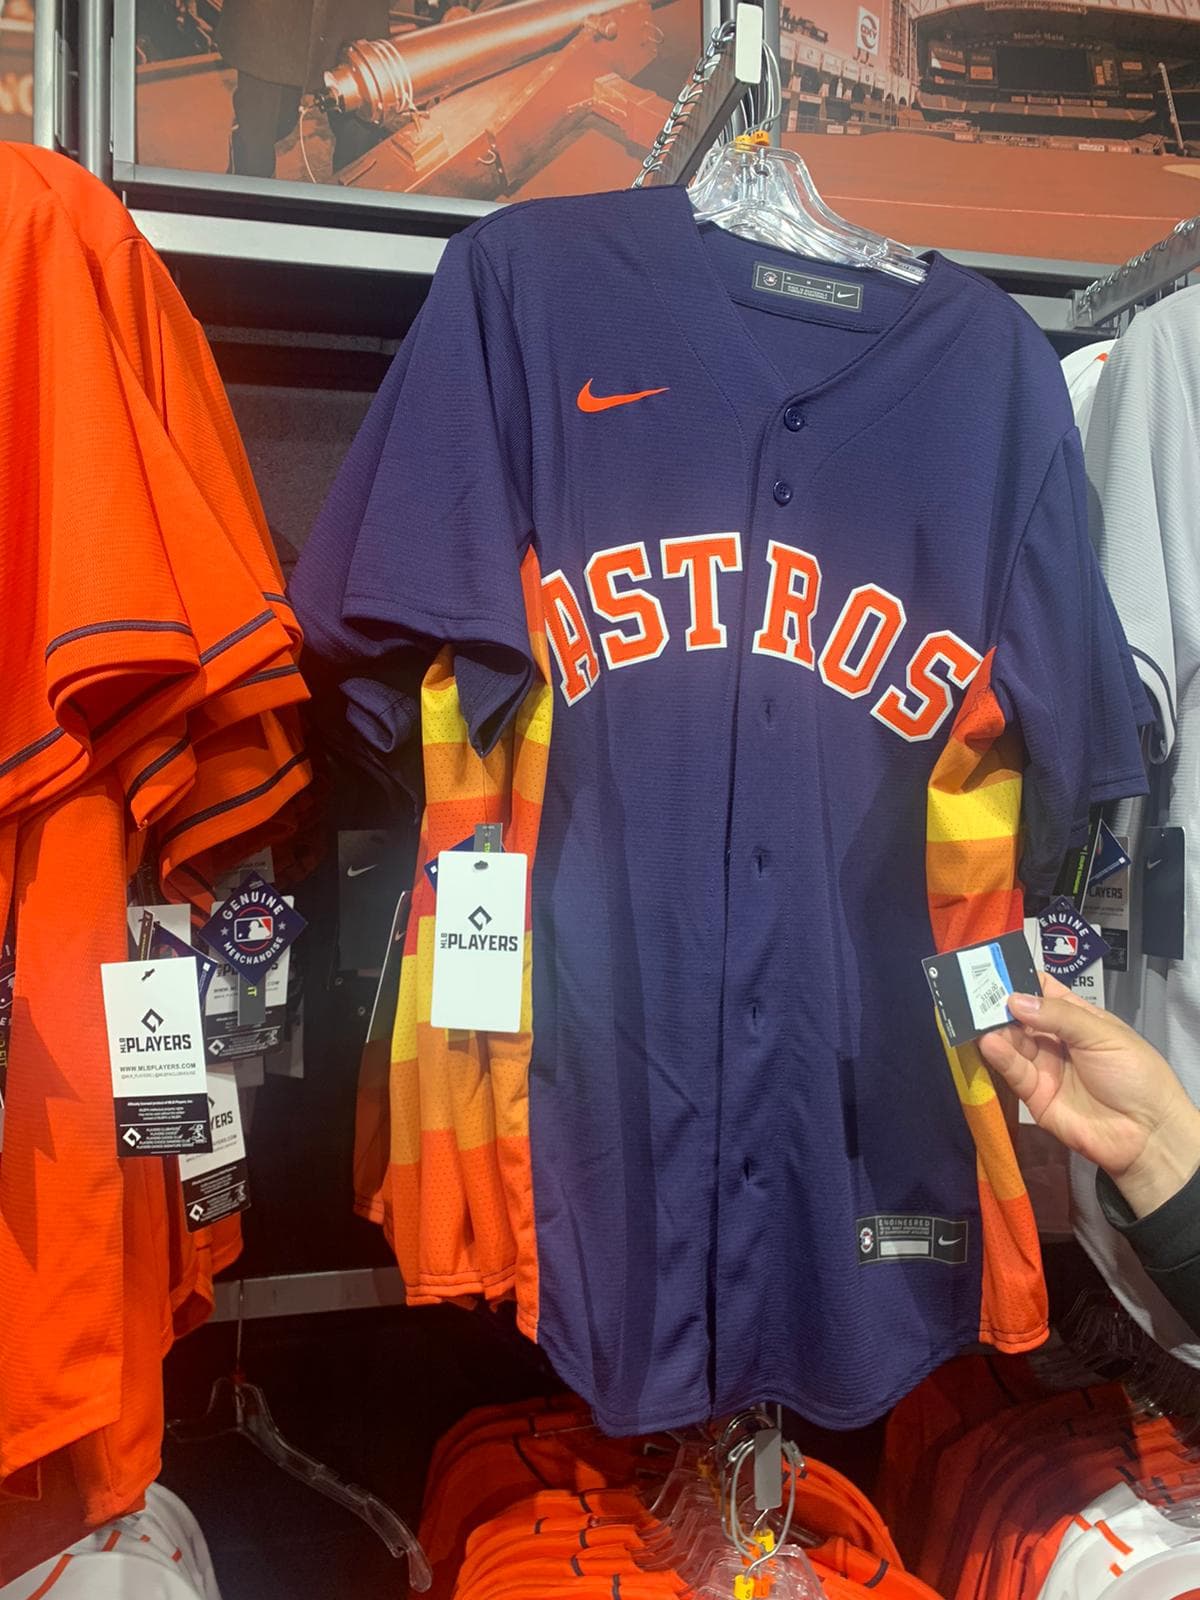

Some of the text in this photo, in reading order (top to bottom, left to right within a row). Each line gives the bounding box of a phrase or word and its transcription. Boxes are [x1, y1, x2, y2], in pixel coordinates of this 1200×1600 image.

[541, 531, 985, 743] ASTROS
[222, 890, 284, 921] GENUINE
[1089, 887, 1123, 899] LAYERS
[1039, 912, 1090, 938] ENUINE
[223, 936, 284, 966] MERCHANDISE
[447, 933, 519, 952] PLAYERS
[126, 1033, 192, 1053] PLAYERS
